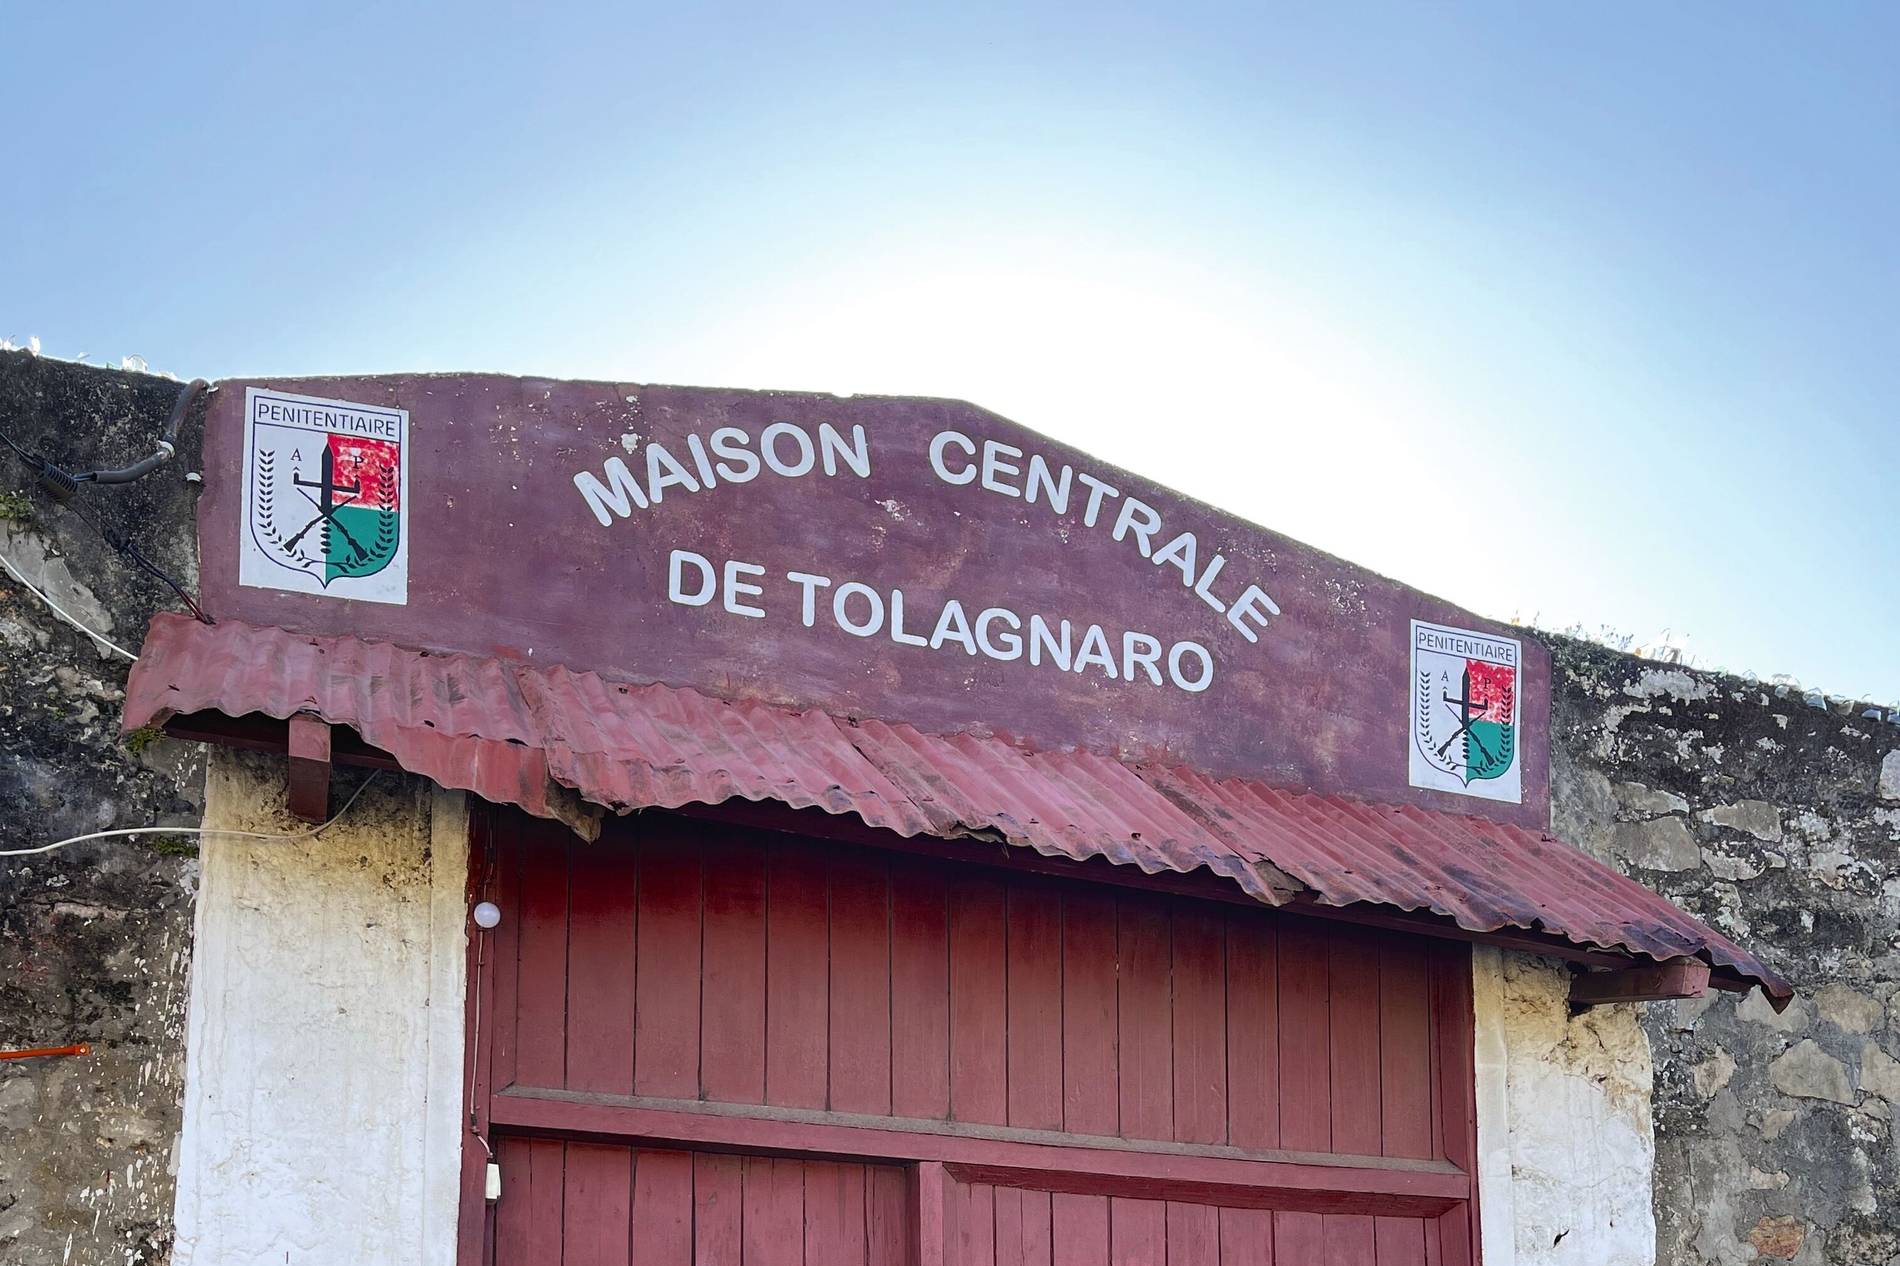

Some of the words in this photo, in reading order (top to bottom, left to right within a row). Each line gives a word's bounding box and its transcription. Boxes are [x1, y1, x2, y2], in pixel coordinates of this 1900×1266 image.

[258, 403, 395, 437] PENITENTIAIRE
[290, 448, 302, 462] A
[353, 455, 365, 470] P
[573, 422, 871, 527] MAISON
[929, 430, 1282, 644] CENTRALE
[668, 549, 766, 618] DE
[786, 571, 1215, 692] TOLAGNARO
[1418, 632, 1513, 662] PENITENTIAIRE
[1441, 670, 1449, 682] A
[1484, 677, 1492, 689] P
